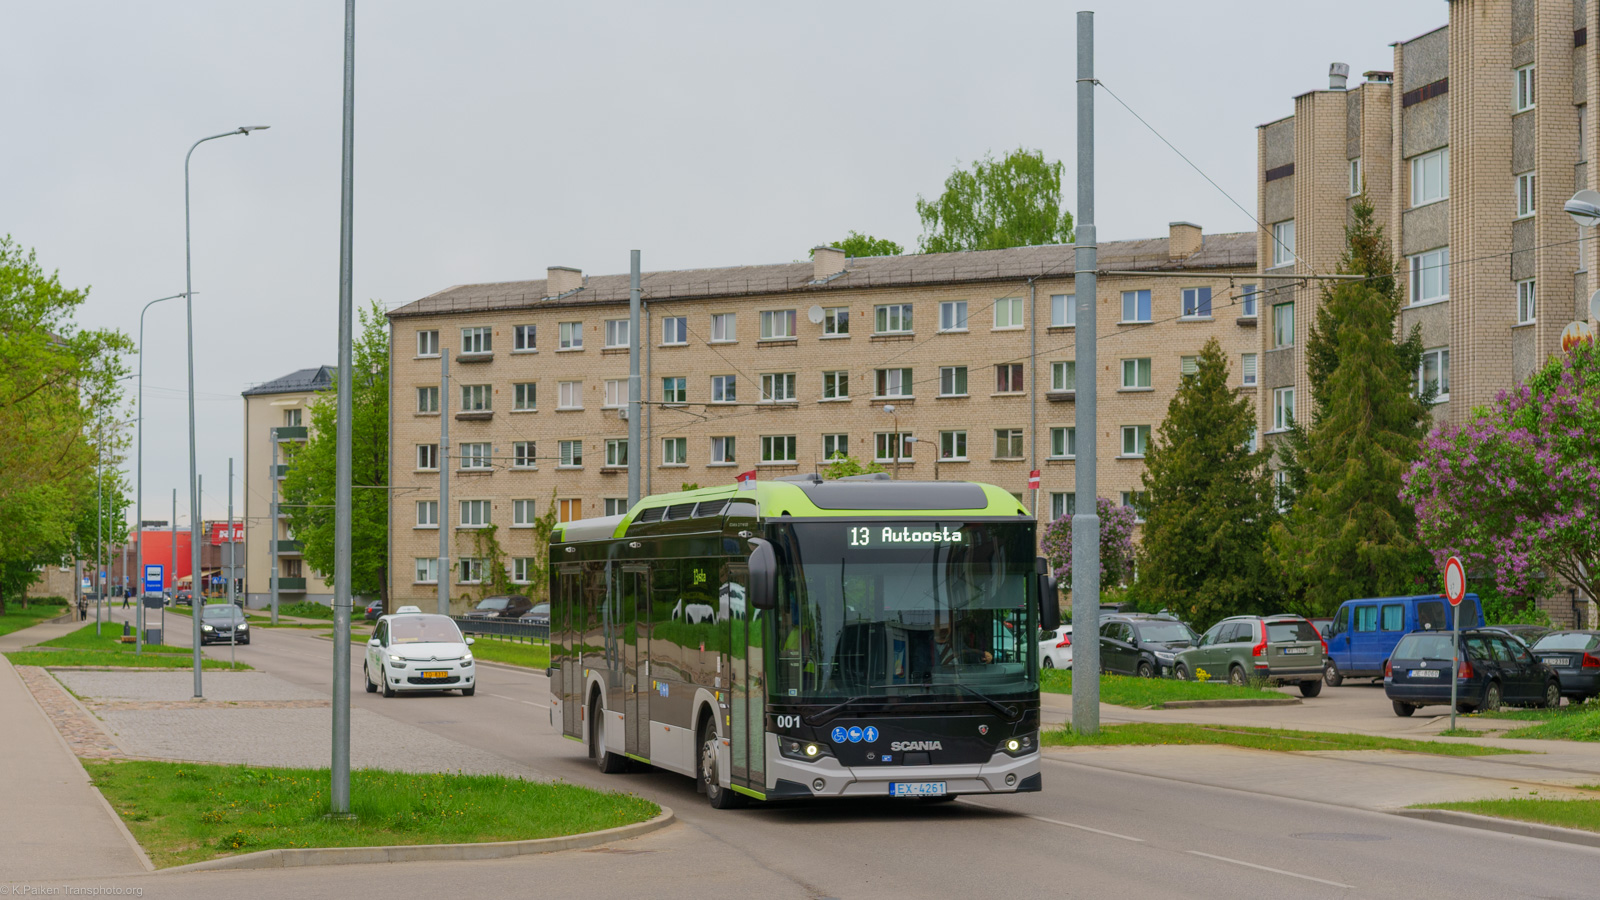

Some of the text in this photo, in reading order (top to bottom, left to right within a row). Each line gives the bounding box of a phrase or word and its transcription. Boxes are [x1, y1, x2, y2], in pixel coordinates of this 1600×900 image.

[851, 526, 962, 546] 13 Autoosta
[776, 715, 801, 728] 001
[890, 740, 943, 752] SCANIA
[897, 783, 945, 794] EX-4261
